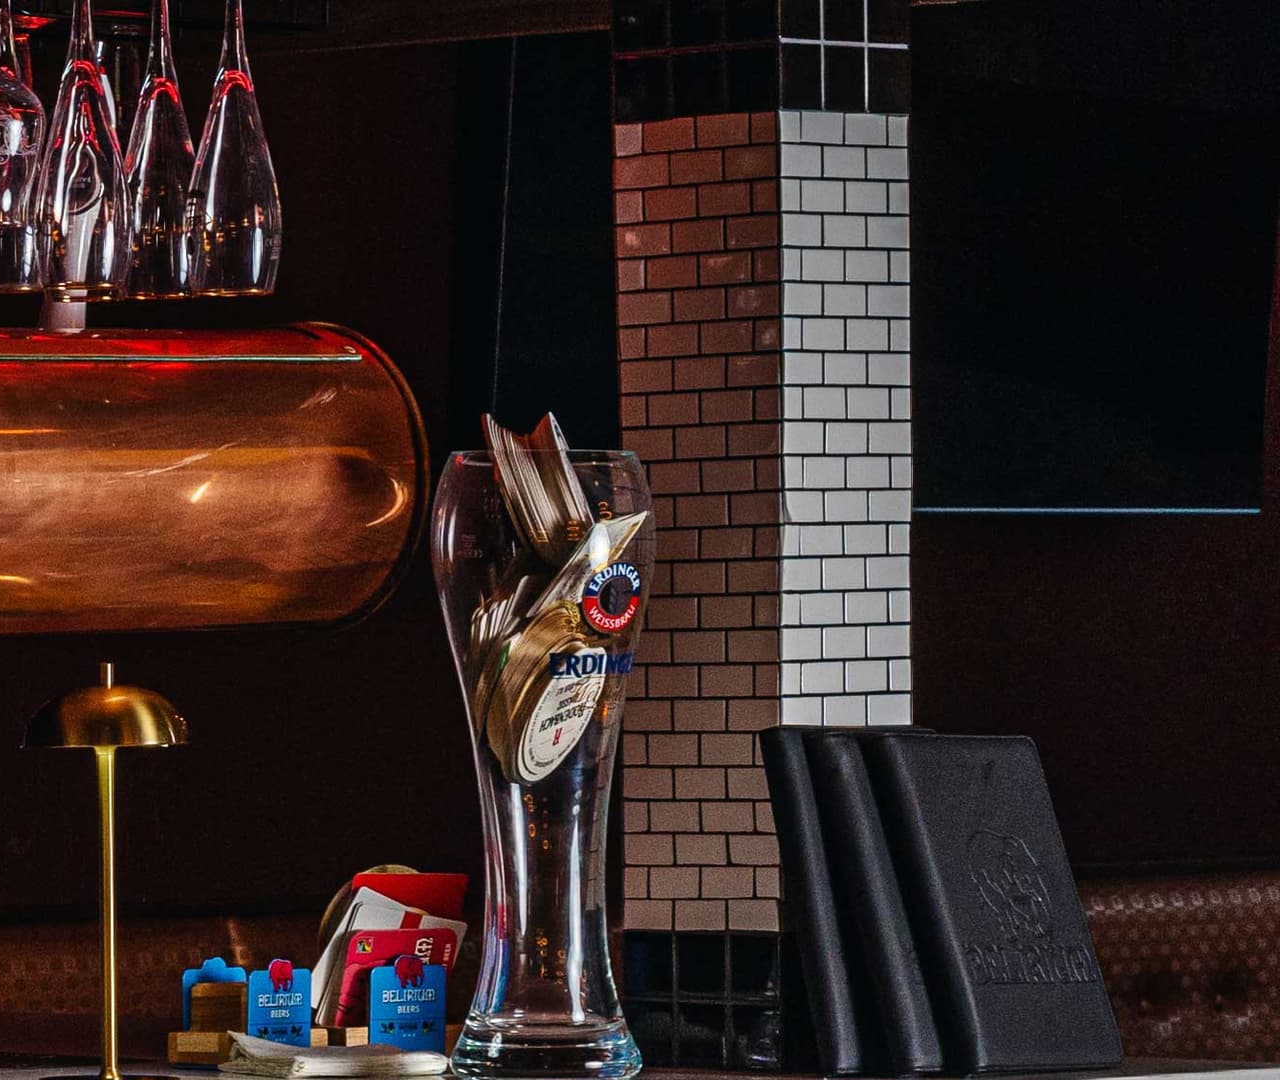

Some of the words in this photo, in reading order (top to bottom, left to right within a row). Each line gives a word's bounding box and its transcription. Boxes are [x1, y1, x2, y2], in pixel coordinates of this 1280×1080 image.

[588, 562, 641, 593] ERDINGER
[549, 652, 633, 679] ERDINGE
[257, 991, 303, 1008] DELIRIUM
[382, 987, 435, 1003] DELIRIUM
[270, 1008, 290, 1019] BEERS
